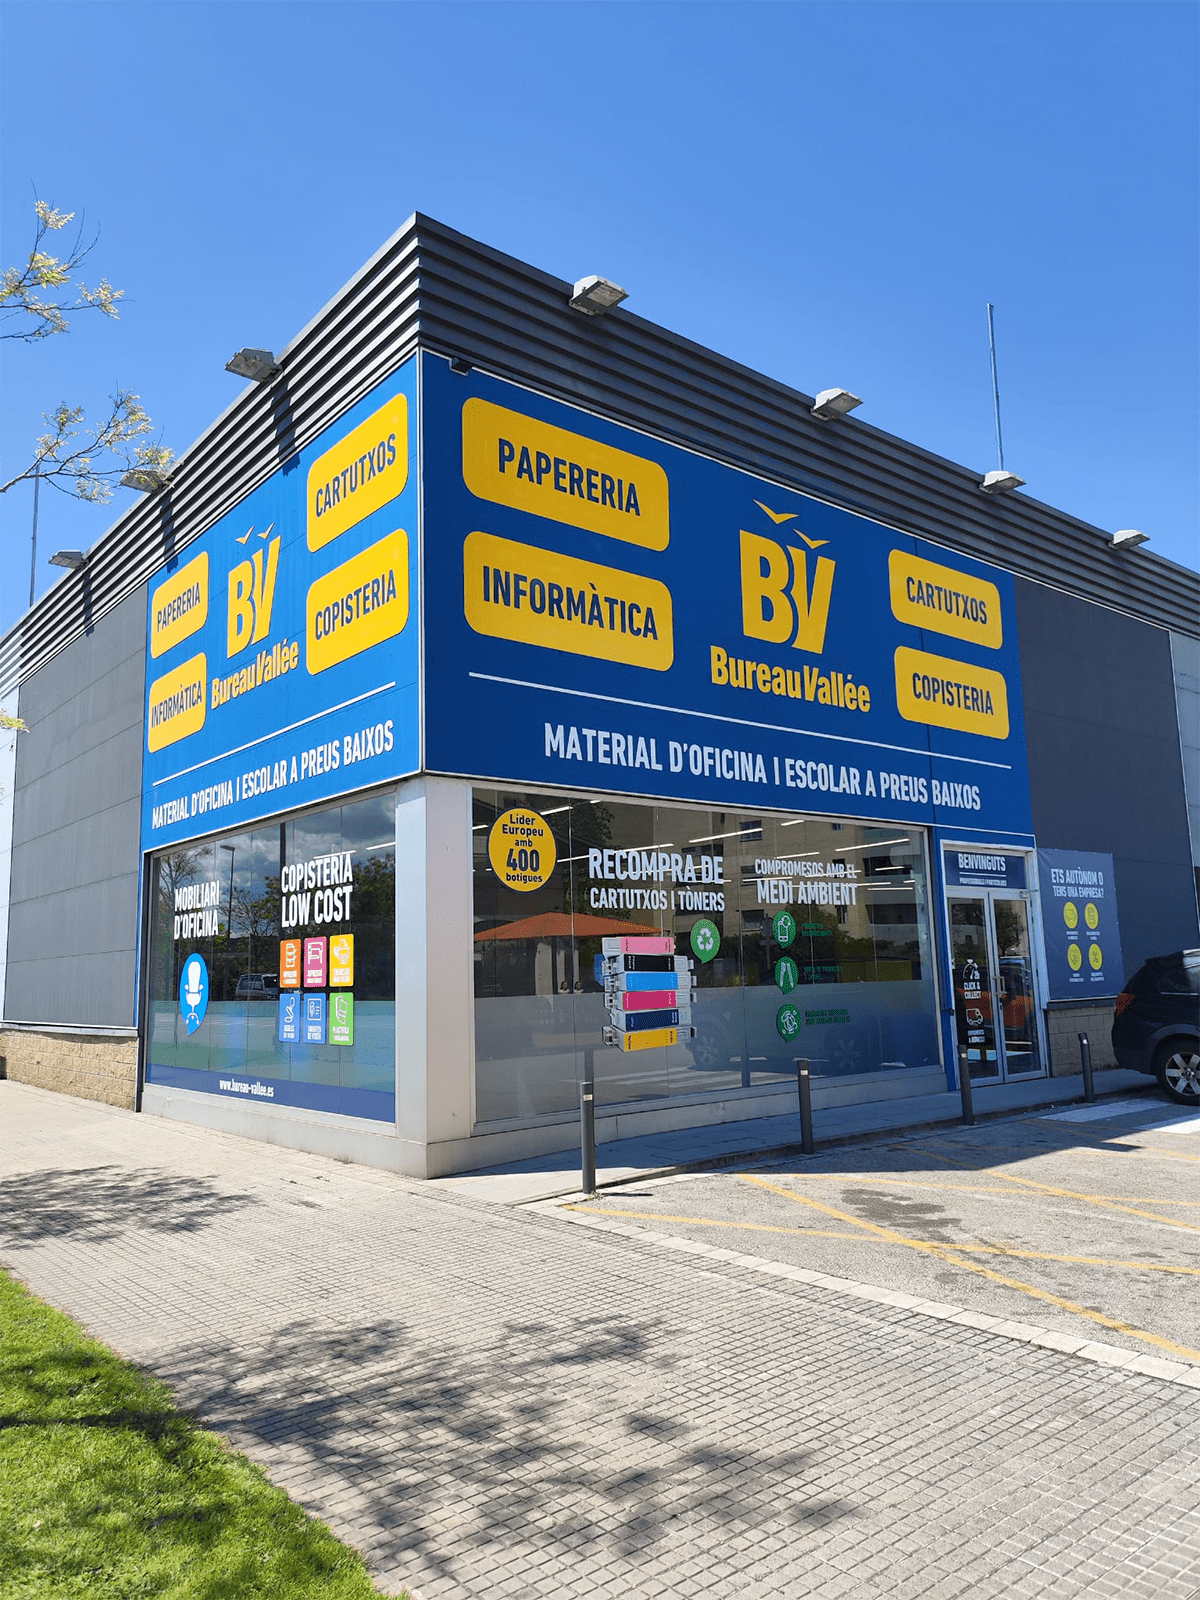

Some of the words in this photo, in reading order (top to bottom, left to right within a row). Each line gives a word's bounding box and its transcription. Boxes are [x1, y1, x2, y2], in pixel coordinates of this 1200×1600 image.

[315, 434, 396, 518] CARTUTXOS
[499, 437, 641, 517] PAPERERIA
[157, 582, 201, 632] PAPERERIA
[227, 535, 282, 659] BV
[315, 569, 397, 641] COPISTERIA
[483, 565, 658, 641] INFORMÀTICA
[740, 529, 836, 655] BV
[906, 576, 988, 625] CARTUTXOS
[151, 680, 203, 728] INFORMÀTICA
[912, 672, 994, 716] COPISTERIA
[152, 796, 190, 830] MATERIAL
[191, 780, 234, 818] D'OFICINA
[242, 759, 287, 801] ESCOLAR
[289, 756, 299, 785] A
[301, 740, 340, 781] PREUS
[343, 720, 394, 766] BAIXOS
[545, 722, 662, 772] MATERIAL
[669, 741, 767, 784] D'OFICINA
[774, 756, 780, 786] I
[785, 759, 862, 796] ESCOLAR
[865, 770, 877, 798] A
[881, 771, 928, 804] PREUS
[932, 779, 981, 811] BAIXOS
[502, 824, 544, 838] Europeu
[515, 838, 533, 848] amb
[281, 853, 353, 894] COPISTERIA
[506, 848, 540, 872] 400
[506, 873, 543, 884] botigues
[588, 848, 696, 883] RECOMPRA
[702, 855, 724, 885] DE
[755, 859, 823, 877] COMPROMESOS
[826, 863, 845, 878] AMB
[958, 853, 1006, 871] BENVINGUTS
[1051, 869, 1064, 884] ETS
[1066, 866, 1097, 885] AUTÒNOM
[1098, 871, 1104, 885] O
[174, 880, 220, 911] MOBILIARI
[281, 893, 310, 928] LOW
[314, 885, 353, 925] COST
[590, 887, 668, 911] CARTUTXOS
[671, 890, 675, 910] I
[678, 886, 725, 911] TÒNERS
[756, 879, 794, 904] MEDI
[798, 881, 858, 905] AMBIENT
[174, 909, 219, 940] D'OFICINA
